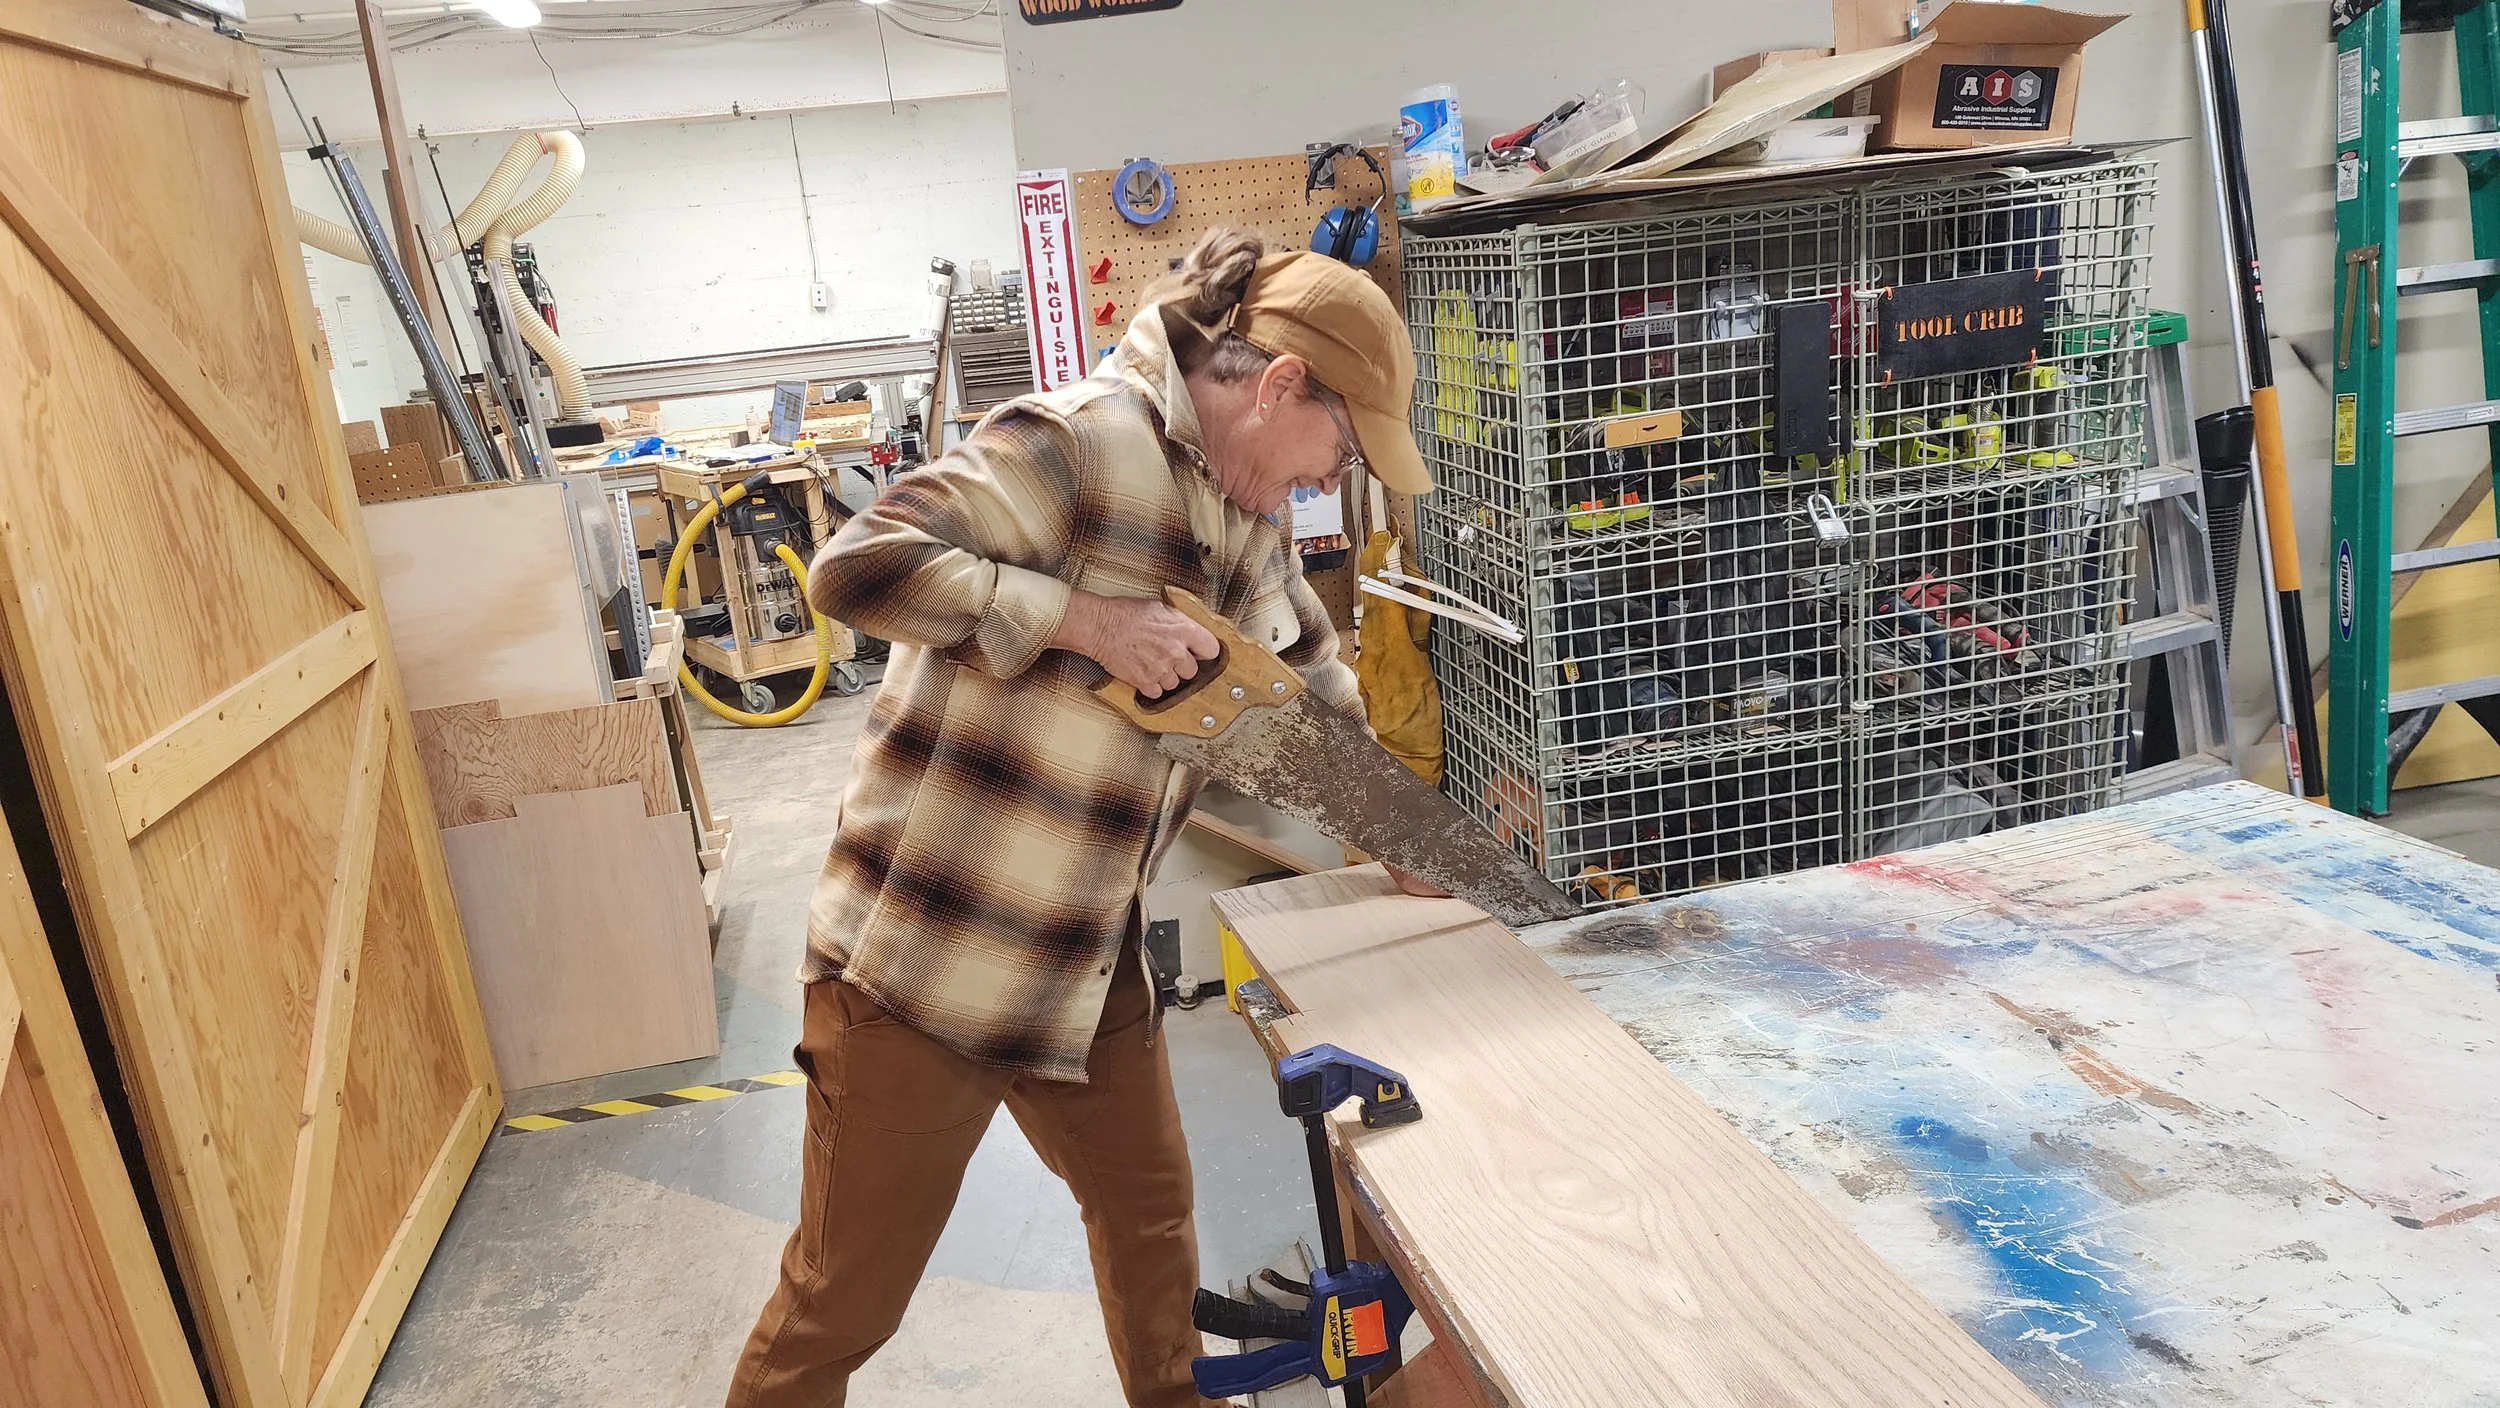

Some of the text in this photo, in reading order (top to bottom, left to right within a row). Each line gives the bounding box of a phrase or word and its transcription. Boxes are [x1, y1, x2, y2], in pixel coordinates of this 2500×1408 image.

[2009, 106, 2036, 114] Supplies
[1023, 193, 1063, 216] FIRE
[1039, 220, 1069, 382] EXTINGUISHE
[1895, 304, 2024, 341] TOOL CRIB
[2340, 560, 2349, 619] WERNER
